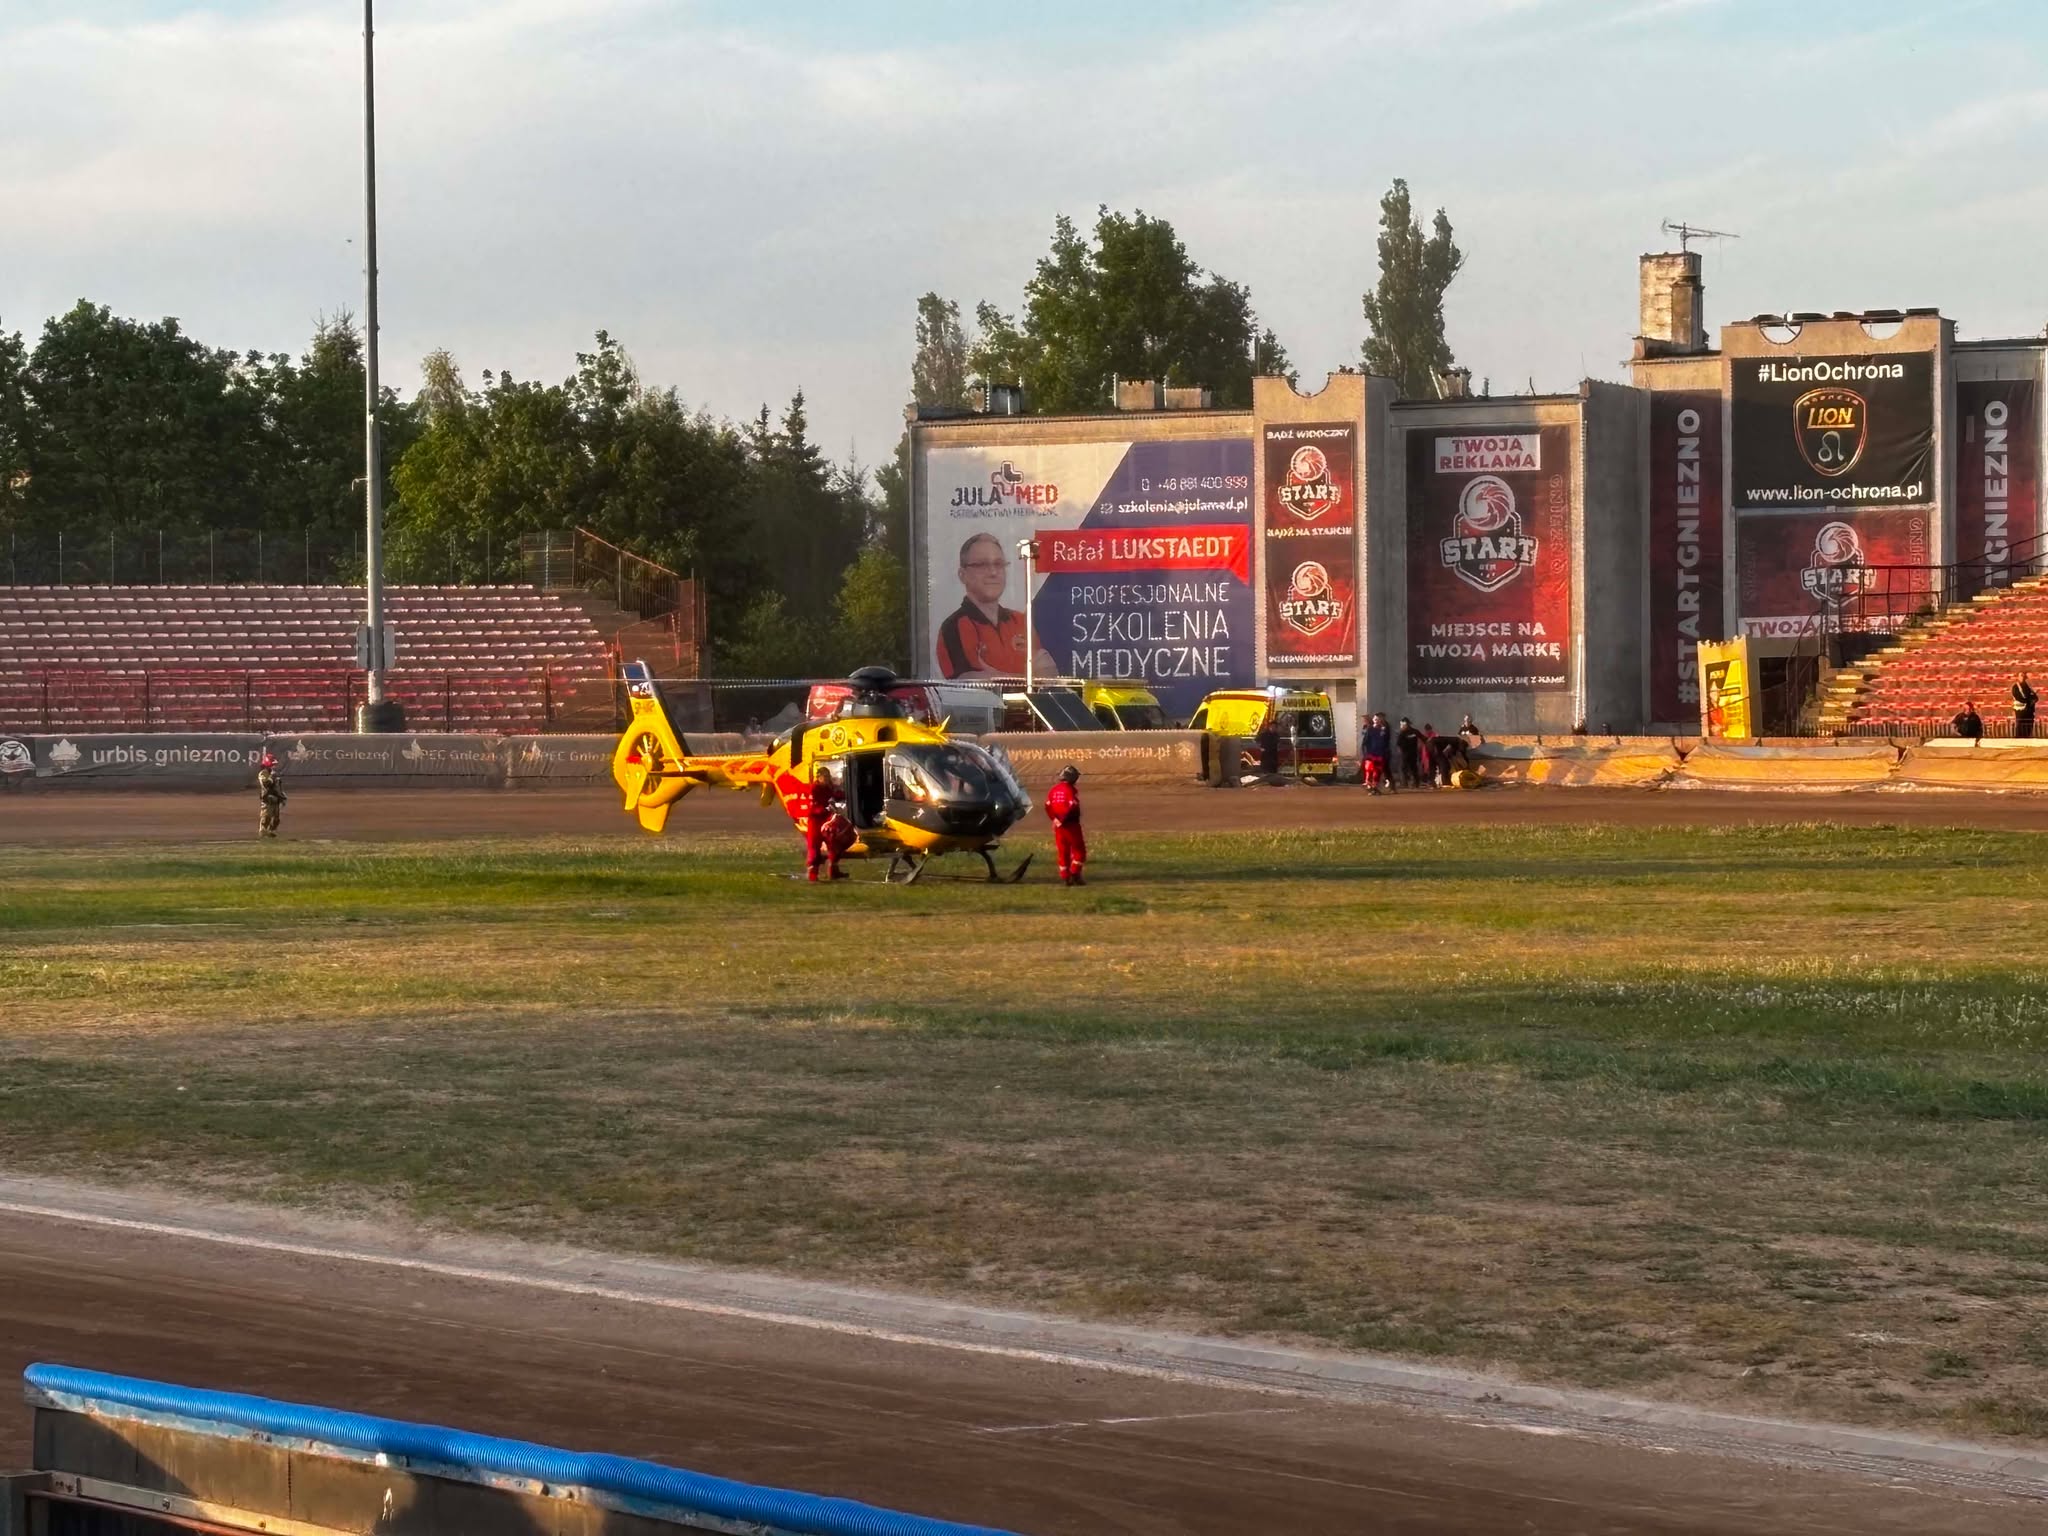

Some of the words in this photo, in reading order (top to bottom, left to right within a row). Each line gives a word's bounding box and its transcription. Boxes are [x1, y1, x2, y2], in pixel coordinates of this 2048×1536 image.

[1758, 362, 1904, 382] #LionOchrona
[1807, 407, 1855, 429] LION
[1452, 437, 1524, 452] TWOJA
[1440, 454, 1537, 470] REKLAMA
[951, 485, 1003, 507] JULA
[1015, 483, 1059, 505] MED
[1280, 484, 1340, 503] START
[1747, 480, 1923, 501] www.lion-ochrona.pl
[1053, 539, 1104, 561] Rafał
[1111, 536, 1233, 560] LUKSTAEDT
[1443, 536, 1534, 564] START
[1677, 408, 1701, 703] #STARTGNIEZNO
[1071, 582, 1231, 605] PROFESJONALNE
[1281, 599, 1341, 617] START
[1071, 608, 1230, 643] SZKOLENIA
[1431, 622, 1511, 637] MIEJSCE
[1518, 622, 1546, 637] NA
[1745, 617, 1819, 636] TWOJA
[1071, 646, 1231, 679] MEDYCZNE
[1416, 642, 1486, 662] TWOJĄ
[1492, 642, 1561, 661] MARKĘ
